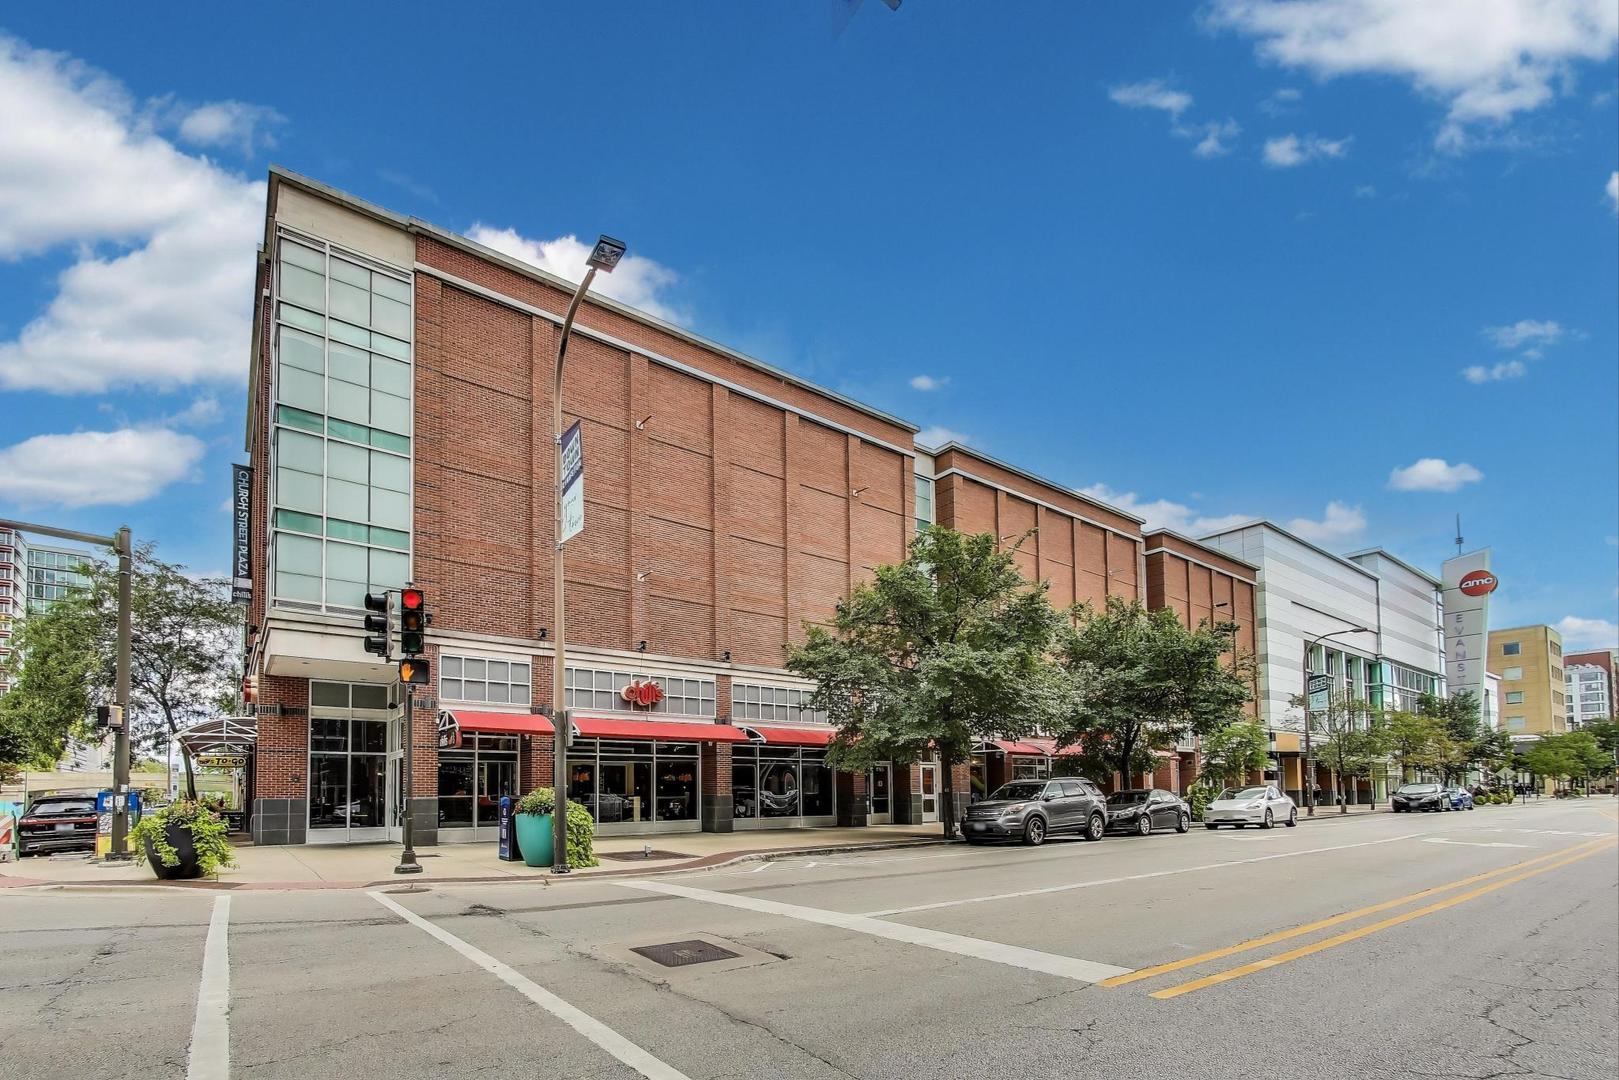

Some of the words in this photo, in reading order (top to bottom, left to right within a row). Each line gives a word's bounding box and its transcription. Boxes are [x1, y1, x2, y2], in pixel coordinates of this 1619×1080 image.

[238, 470, 249, 509] CHURCH
[237, 510, 249, 545] STREET
[238, 546, 248, 576] PLAZA
